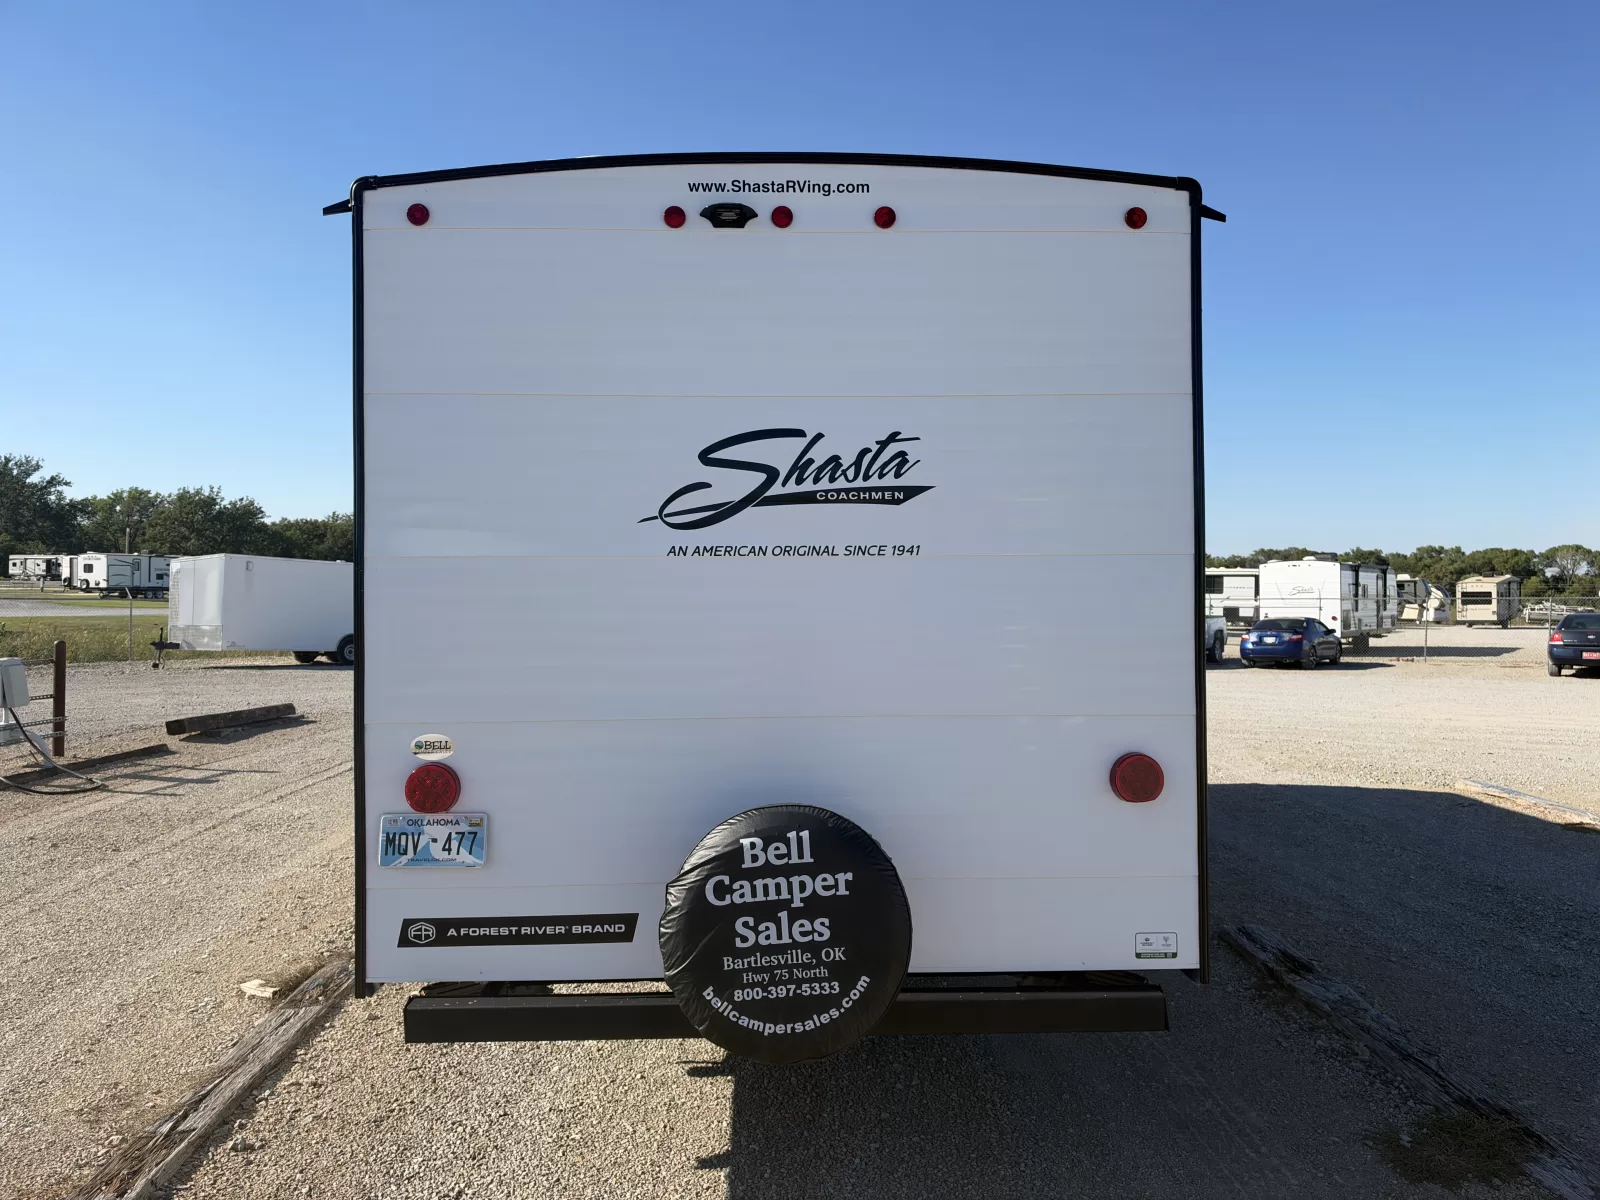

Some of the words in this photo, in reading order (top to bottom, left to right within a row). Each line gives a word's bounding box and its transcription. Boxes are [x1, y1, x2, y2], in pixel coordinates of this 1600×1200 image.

[688, 179, 870, 196] www.ShastaRVing.com
[658, 428, 921, 530] Shasta
[816, 491, 905, 500] COACHMEN
[666, 545, 689, 557] AN
[691, 545, 767, 557] AMERICAN
[771, 545, 840, 557] ORIGINAL
[843, 545, 887, 556] SINCE
[890, 544, 921, 556] 1941
[424, 740, 452, 750] BELL
[406, 818, 460, 827] OKLAHOMA
[384, 832, 422, 856] MQV
[441, 832, 478, 856] 477
[739, 829, 814, 868] Bell
[704, 871, 853, 908] Camper
[447, 928, 458, 937] A
[460, 926, 519, 936] FOREST
[572, 924, 625, 934] BRAND
[734, 911, 831, 948] Sales
[722, 949, 816, 970] Bartlesville,
[821, 947, 847, 962] OK
[742, 971, 770, 985] Hwy
[773, 969, 789, 981] 75
[793, 966, 829, 979] North
[733, 981, 840, 1001] 800-397-5333
[702, 974, 871, 1036] bellcampersales.com
